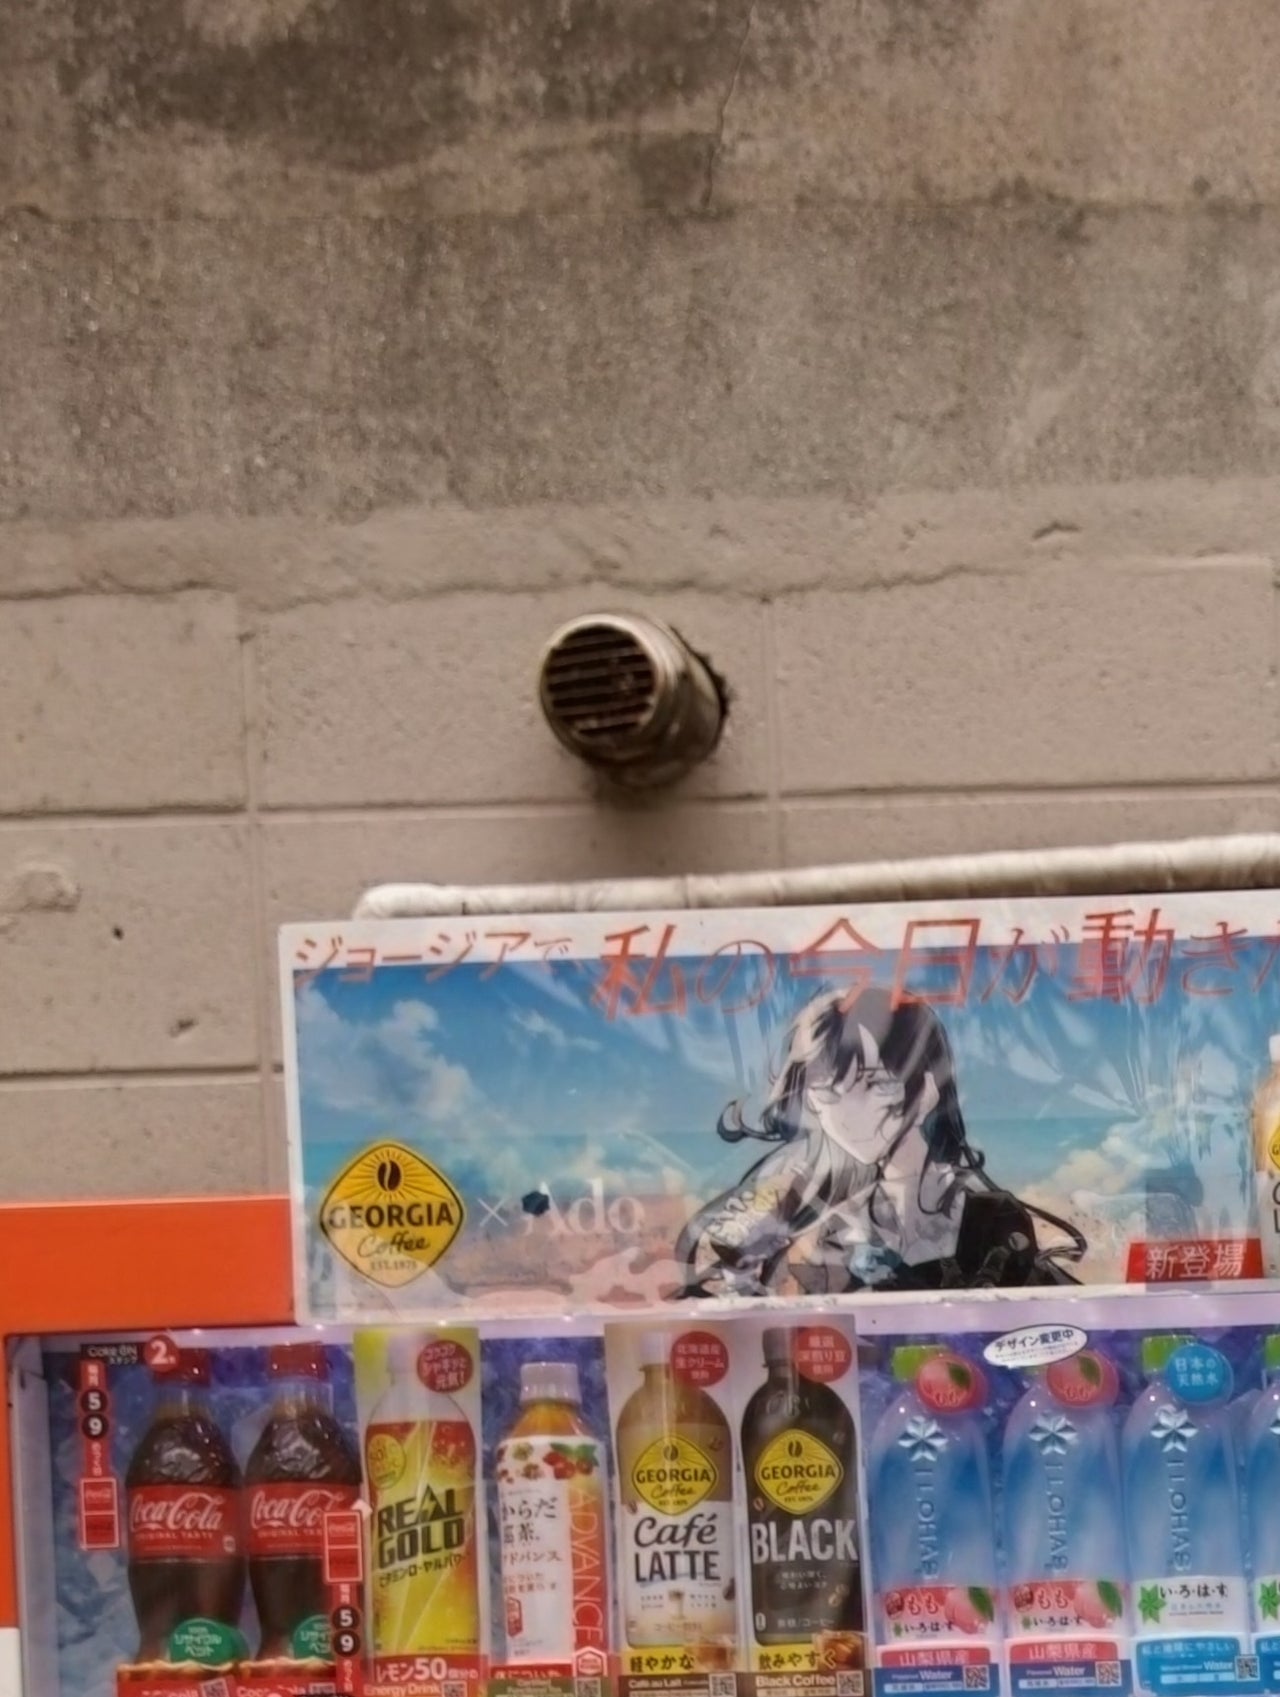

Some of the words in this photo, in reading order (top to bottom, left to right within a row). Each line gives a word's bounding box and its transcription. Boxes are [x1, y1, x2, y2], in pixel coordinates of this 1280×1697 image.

[330, 1203, 455, 1228] GEORGIA
[357, 1232, 431, 1258] Coffee
[1145, 1243, 1245, 1279] 新登場
[994, 1328, 1075, 1353] デザイン変更中
[1175, 1356, 1218, 1371] 日本の
[1175, 1371, 1220, 1387] 天然水
[635, 1468, 712, 1484] GEORGIA
[760, 1464, 836, 1481] GEORGIA
[128, 1490, 225, 1532] Coca-Cola
[378, 1487, 460, 1539] REAL
[633, 1515, 717, 1548] Café
[751, 1518, 860, 1565] BLACK
[378, 1524, 464, 1571] GOLD
[635, 1548, 721, 1583] LATTE
[629, 1654, 695, 1673] 軽やかな
[759, 1650, 837, 1672] 飲みやすく
[899, 1646, 969, 1665] 山梨県産
[755, 1674, 790, 1688] Black
[793, 1674, 836, 1688] Coffee
